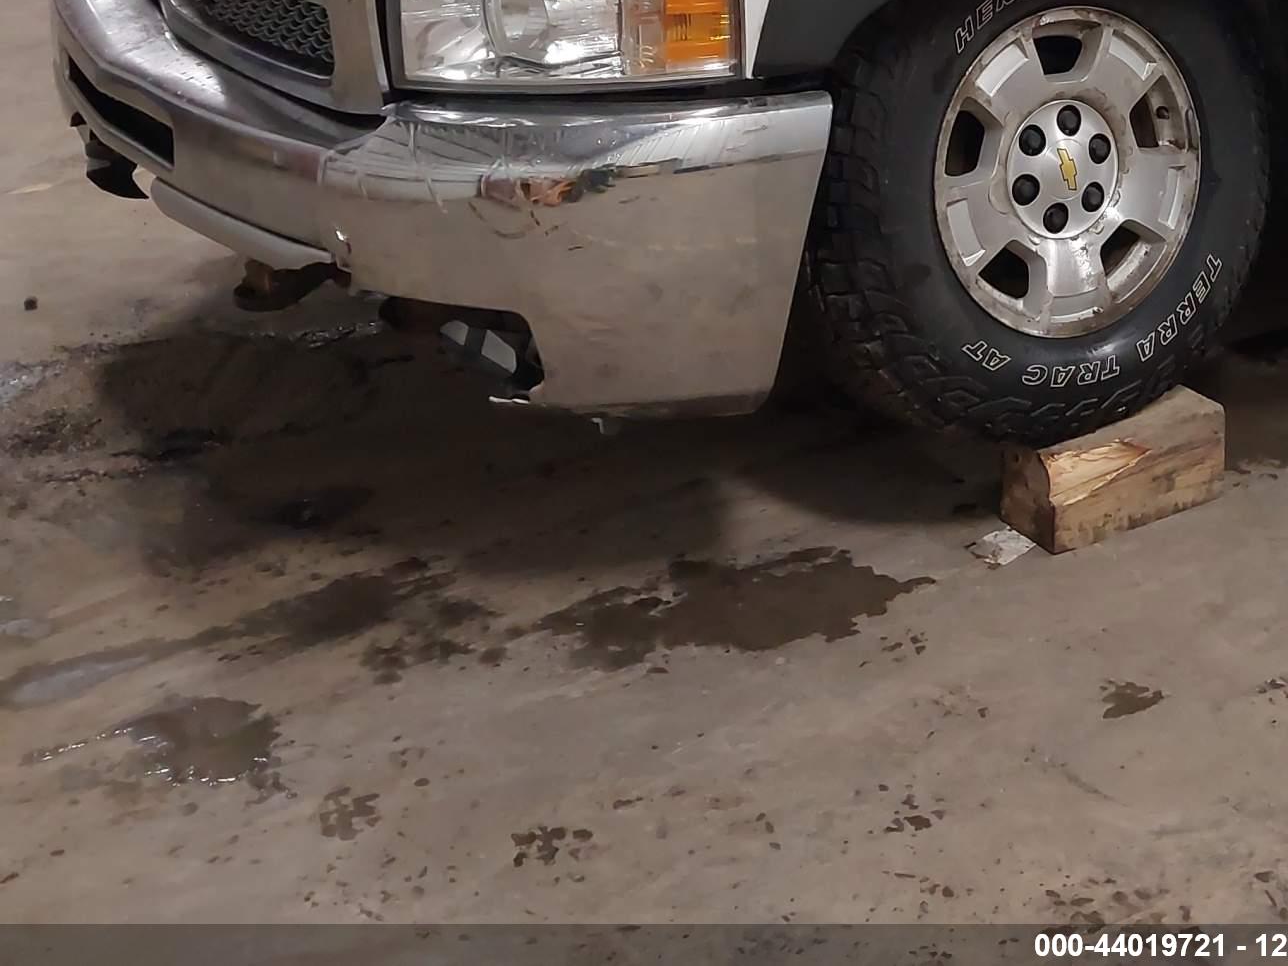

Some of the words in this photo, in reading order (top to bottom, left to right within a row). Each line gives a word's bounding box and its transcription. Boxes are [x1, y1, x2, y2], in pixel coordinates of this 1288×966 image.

[1137, 254, 1222, 362] TERRA
[962, 340, 1012, 371] AT
[1022, 355, 1120, 387] TRAC
